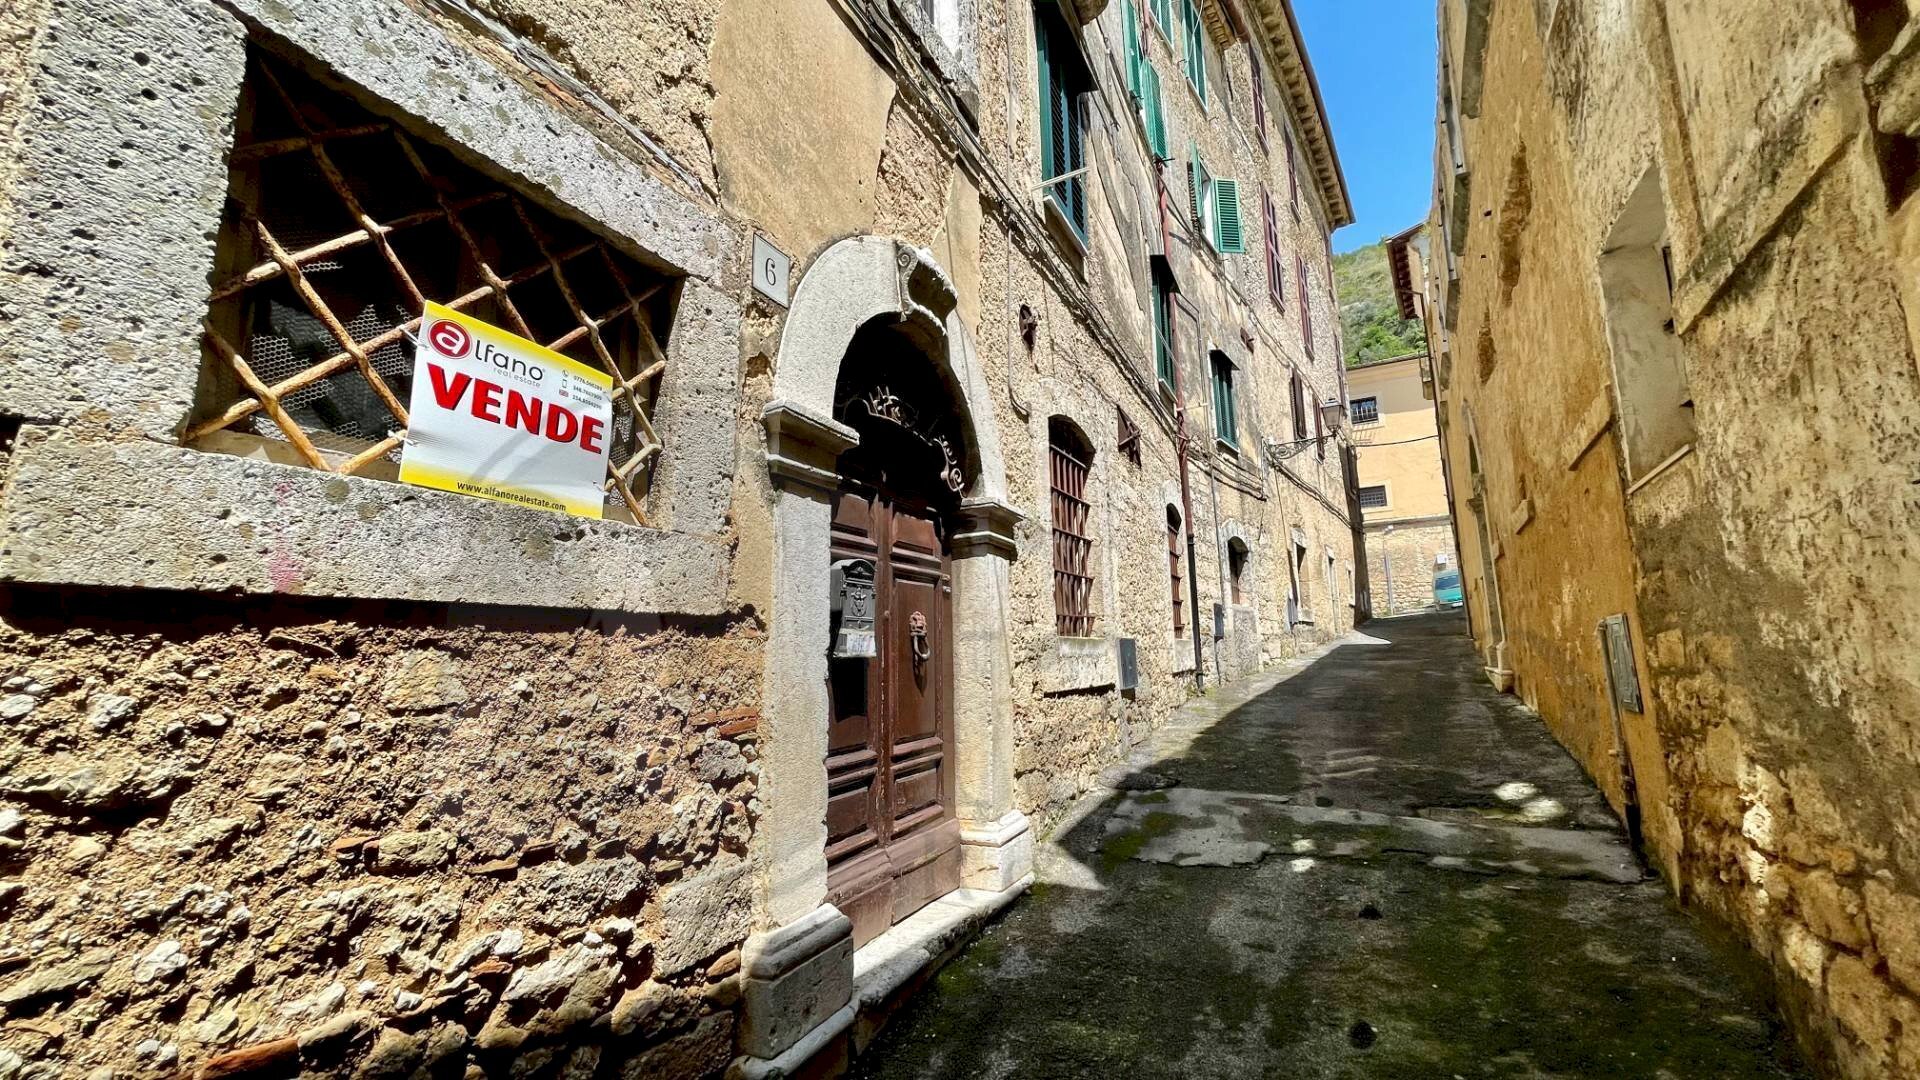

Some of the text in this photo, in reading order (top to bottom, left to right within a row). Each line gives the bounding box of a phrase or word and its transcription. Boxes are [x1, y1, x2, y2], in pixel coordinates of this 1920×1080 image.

[765, 257, 776, 286] 6
[494, 367, 541, 387] real estate
[427, 362, 604, 454] VENDE
[457, 481, 566, 511] www.alfanorealestate.com
